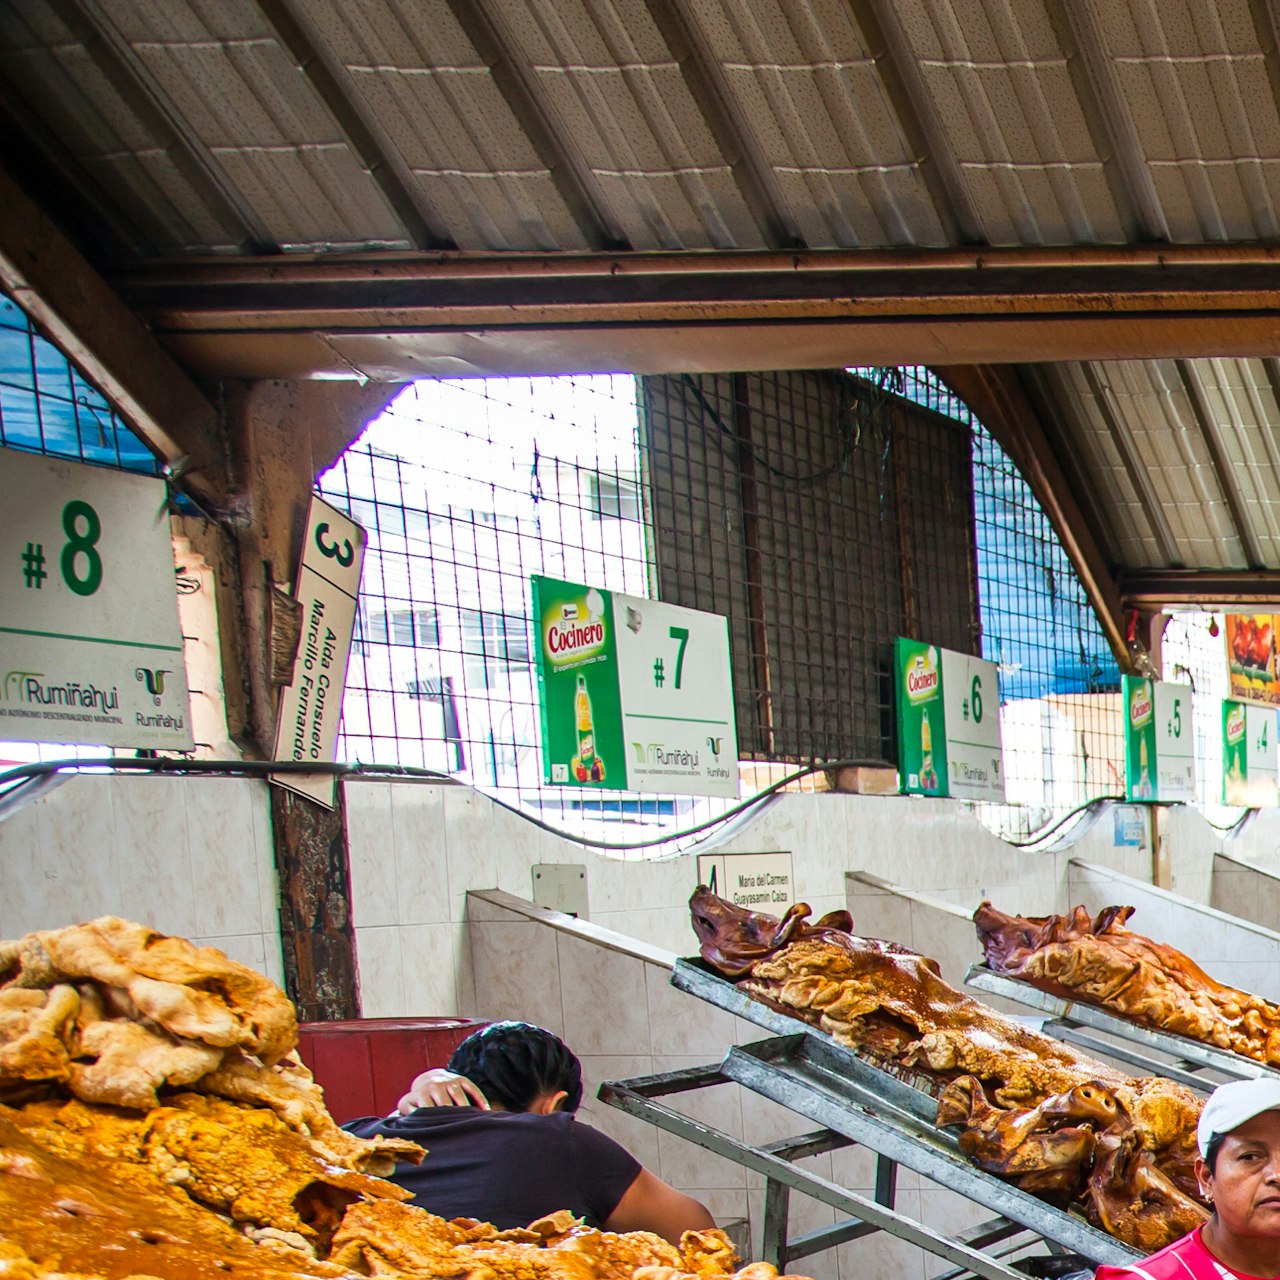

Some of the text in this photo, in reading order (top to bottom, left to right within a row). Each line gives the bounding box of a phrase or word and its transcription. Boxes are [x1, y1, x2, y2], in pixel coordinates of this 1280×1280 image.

[315, 522, 355, 567] 3
[549, 623, 603, 653] Cocinero
[292, 598, 325, 762] Marcillo Fernande
[908, 671, 937, 692] Cocinero
[310, 672, 331, 759] Consuelo
